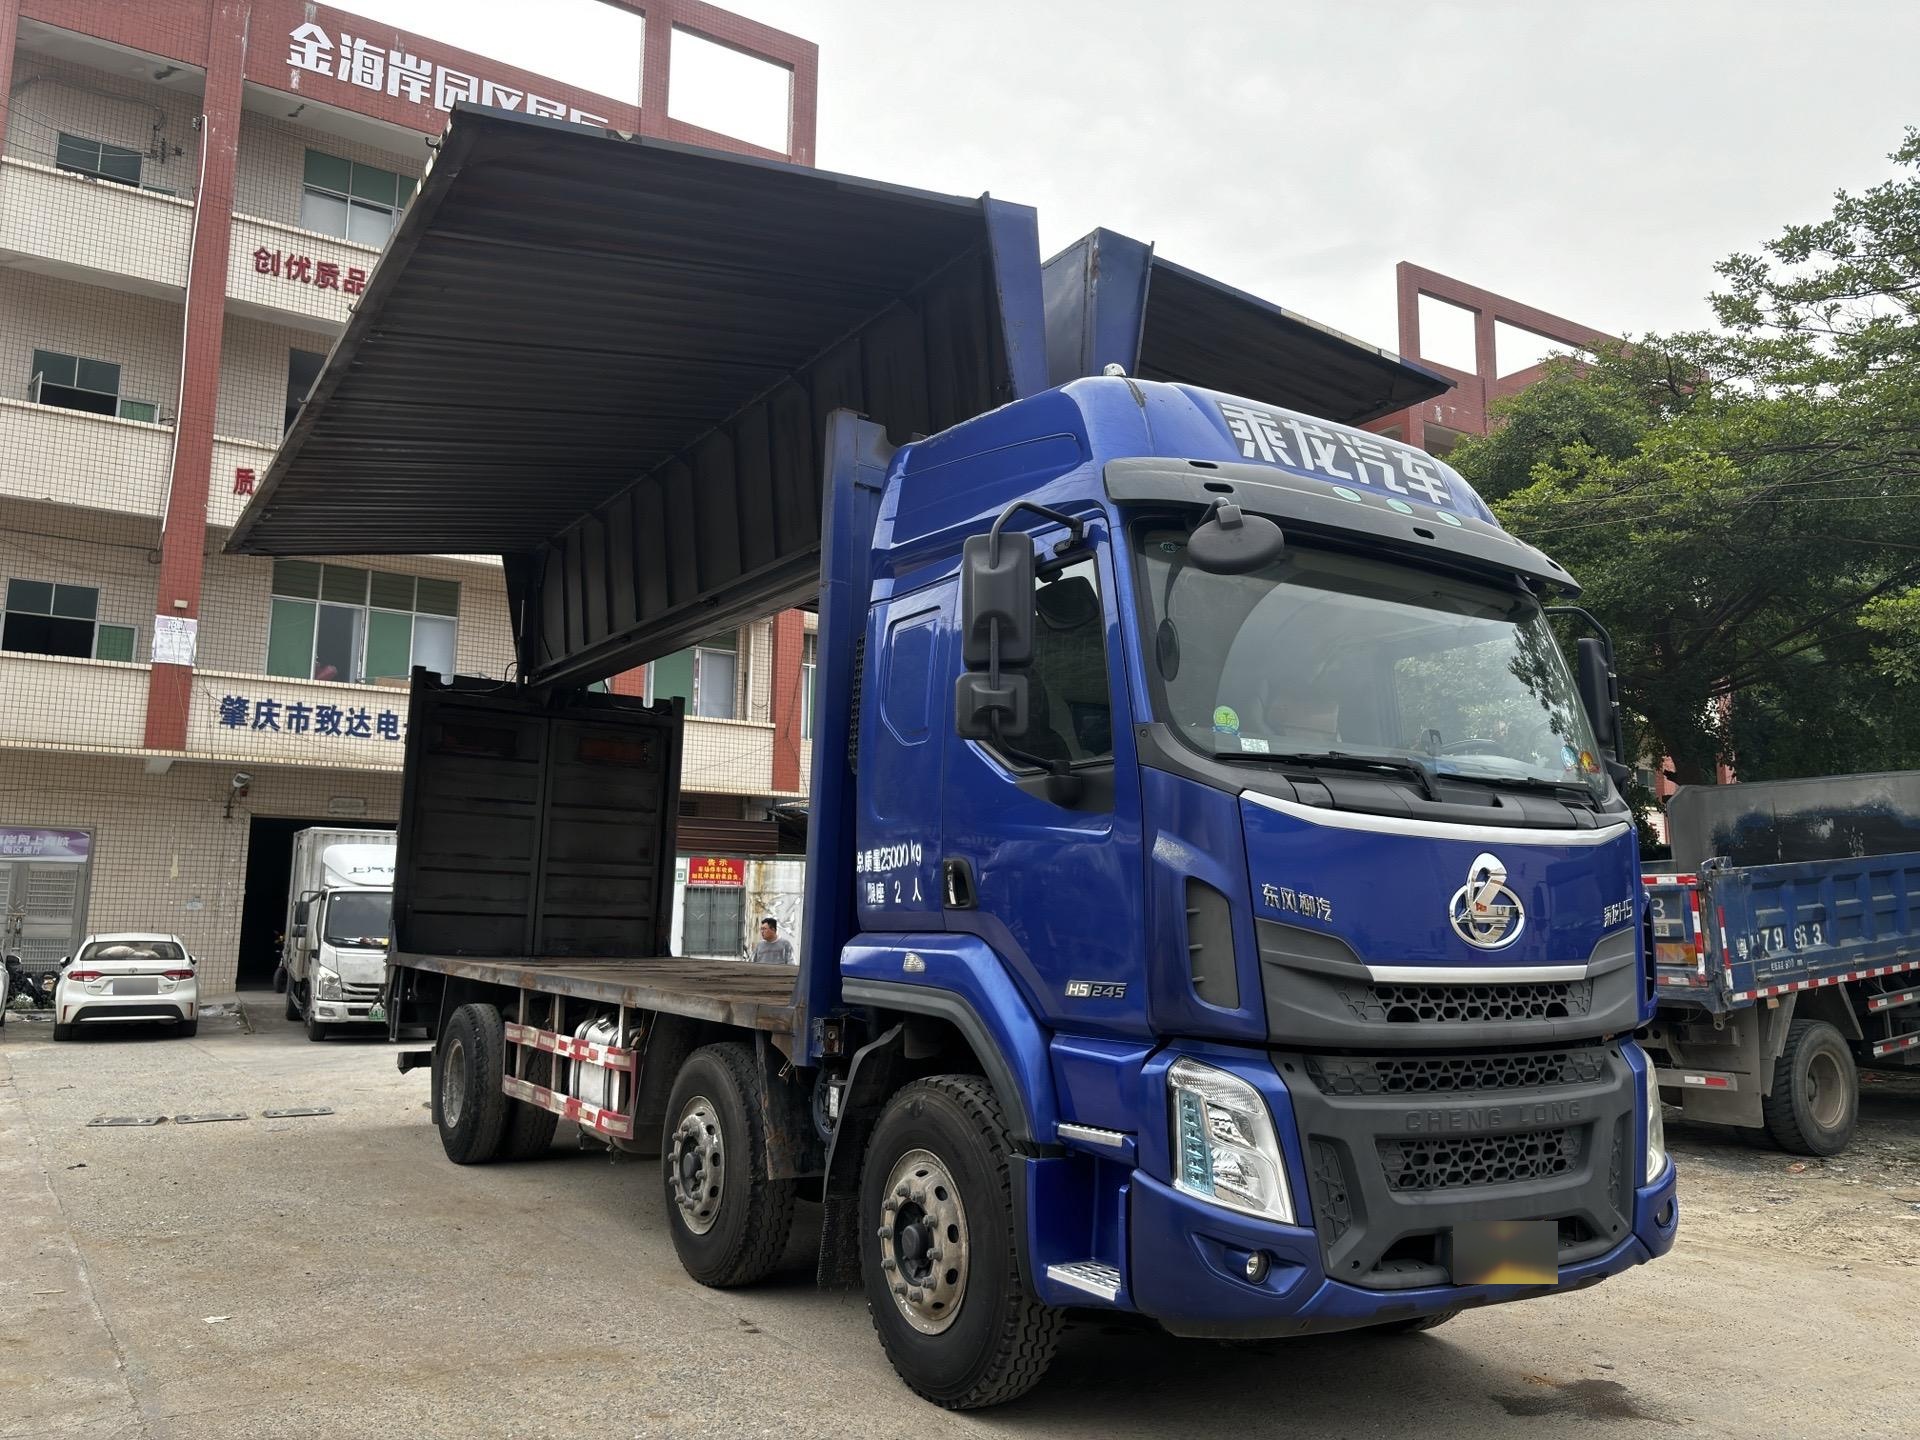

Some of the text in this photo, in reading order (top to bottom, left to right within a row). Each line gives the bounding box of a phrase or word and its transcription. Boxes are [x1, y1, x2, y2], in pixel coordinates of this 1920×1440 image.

[253, 246, 367, 295] 创优质品
[1219, 402, 1451, 504] 乘龙汽车
[233, 467, 256, 496] 质
[219, 694, 408, 744] 肇庆市致达电
[867, 877, 922, 904] 限座 2 人
[1261, 883, 1333, 922] 东风柳汽
[1091, 985, 1126, 998] 245
[1405, 1099, 1582, 1133] CHENG LONG
